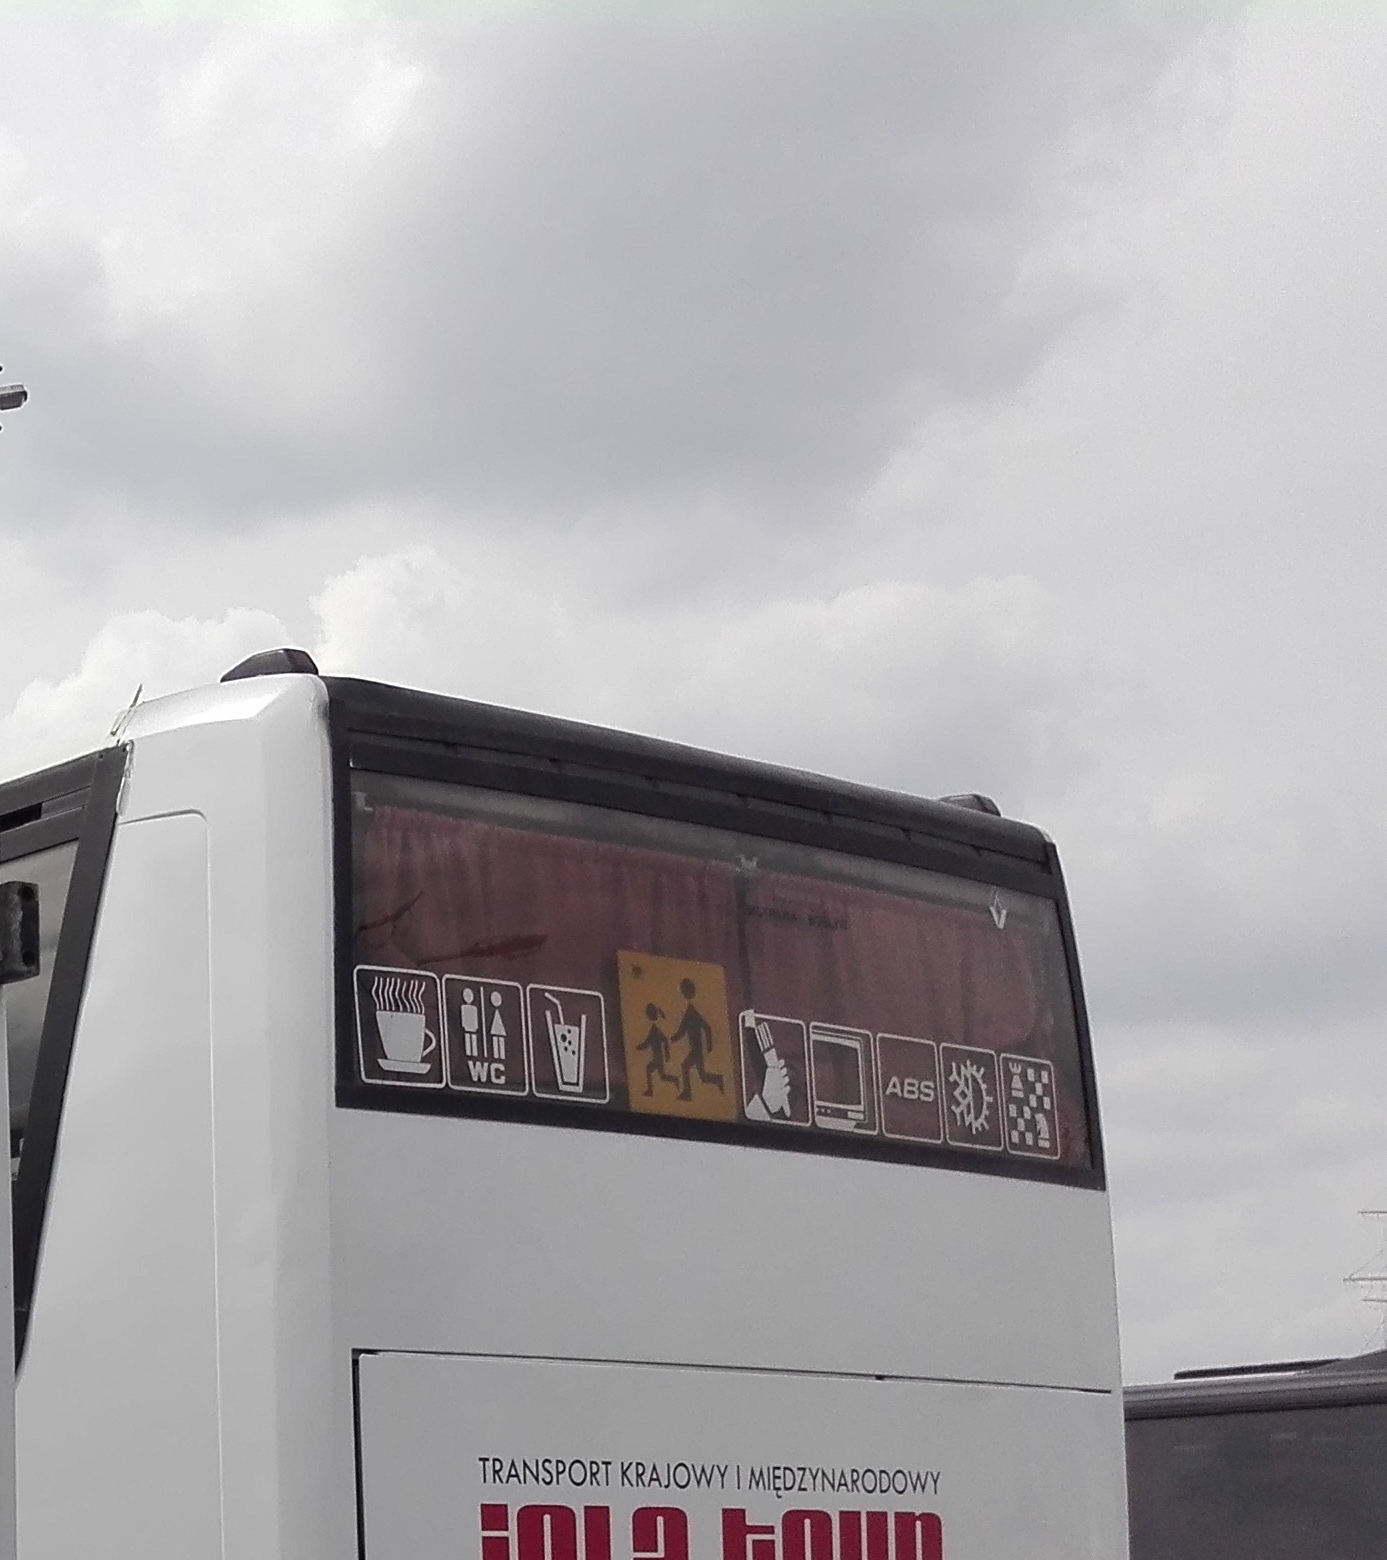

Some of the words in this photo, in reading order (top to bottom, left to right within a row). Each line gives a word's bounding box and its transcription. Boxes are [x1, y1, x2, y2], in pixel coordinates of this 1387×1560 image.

[467, 1060, 506, 1085] WC
[885, 1076, 935, 1102] ABS
[478, 1456, 613, 1489] TRANSPORT
[619, 1461, 728, 1491] KRAJOWY
[736, 1465, 741, 1491] I
[748, 1466, 942, 1499] MIĘDZYNARODOWY
